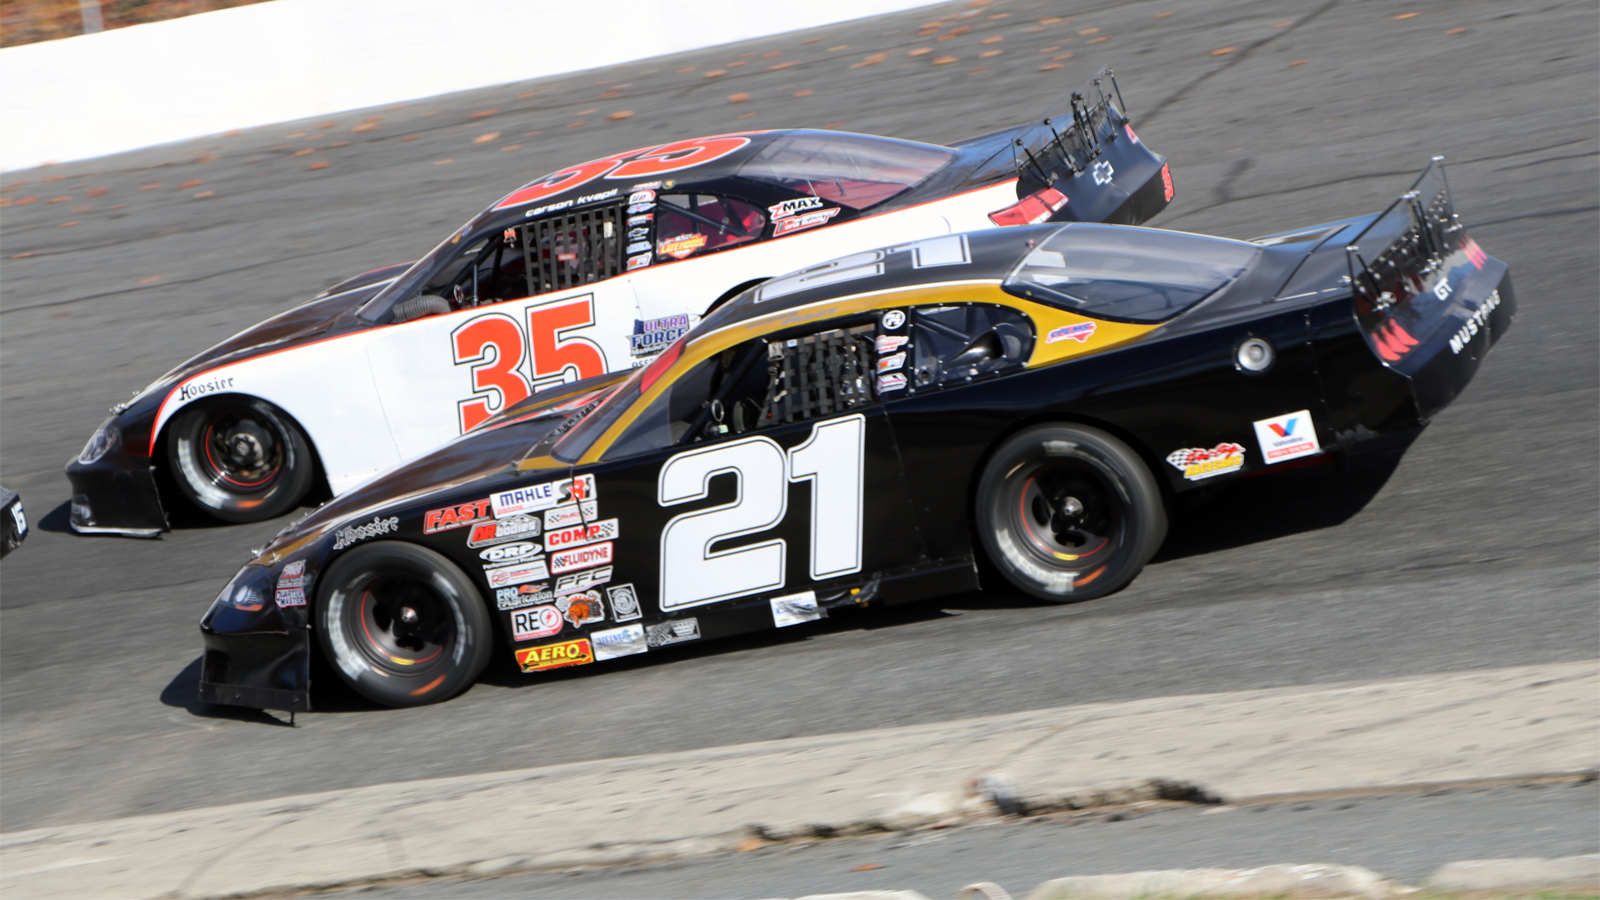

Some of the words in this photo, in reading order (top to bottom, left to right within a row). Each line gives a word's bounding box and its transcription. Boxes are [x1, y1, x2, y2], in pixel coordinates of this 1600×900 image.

[525, 200, 573, 217] carson
[577, 188, 618, 204] kvapil
[1433, 277, 1453, 301] GT
[644, 315, 687, 332] ULTRA
[1449, 289, 1500, 354] MUSTANG
[450, 292, 609, 435] 35
[178, 376, 234, 401] Hoosier
[499, 485, 552, 507] MAHLE
[427, 501, 490, 528] FAST
[496, 505, 523, 516] pistons
[658, 413, 865, 613] 21
[549, 525, 600, 546] COMP
[489, 545, 535, 560] DRP
[563, 547, 608, 566] FLUIDYNE
[557, 567, 611, 590] PFC
[496, 587, 519, 599] PRO
[524, 643, 580, 663] AERO
